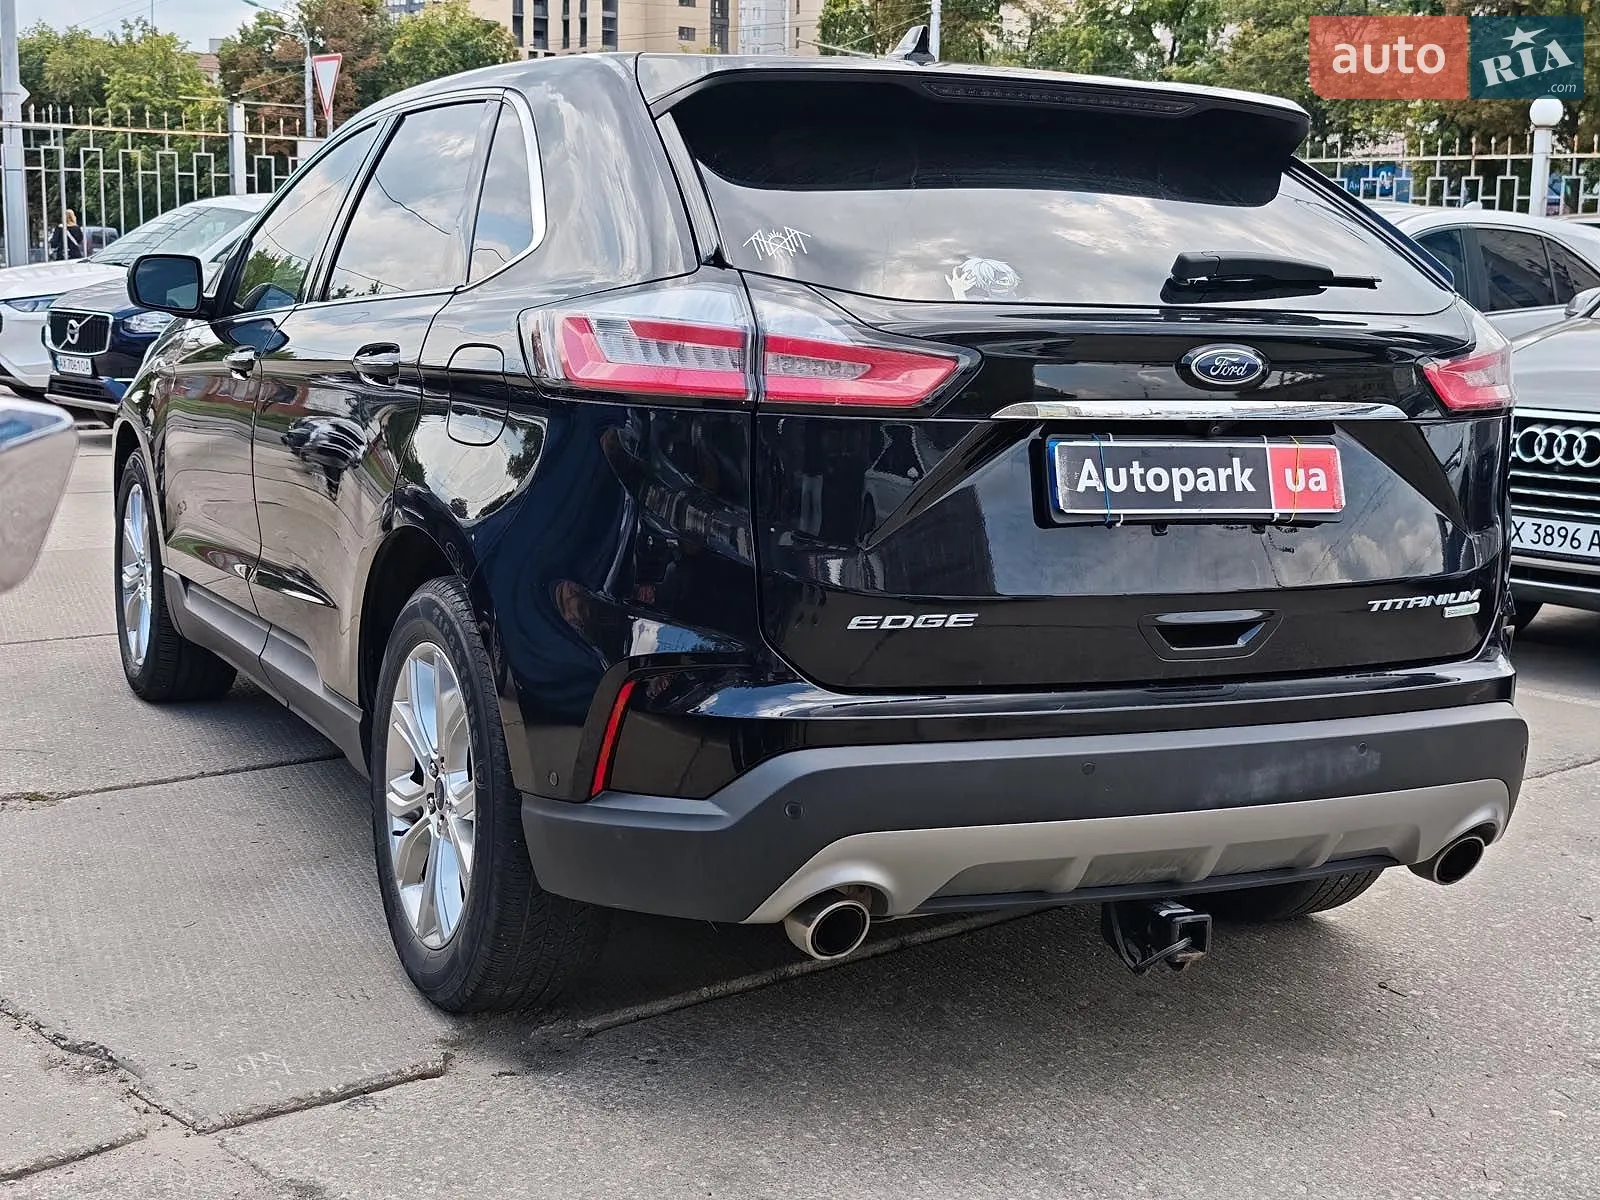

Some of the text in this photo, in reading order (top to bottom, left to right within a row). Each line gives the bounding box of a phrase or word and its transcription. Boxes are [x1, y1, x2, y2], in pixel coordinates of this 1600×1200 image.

[1209, 356, 1249, 376] Ford
[1076, 457, 1328, 502] Autopark ua
[1529, 522, 1582, 550] 3896
[1367, 588, 1482, 612] TITANIUM
[846, 613, 979, 630] EDGE
